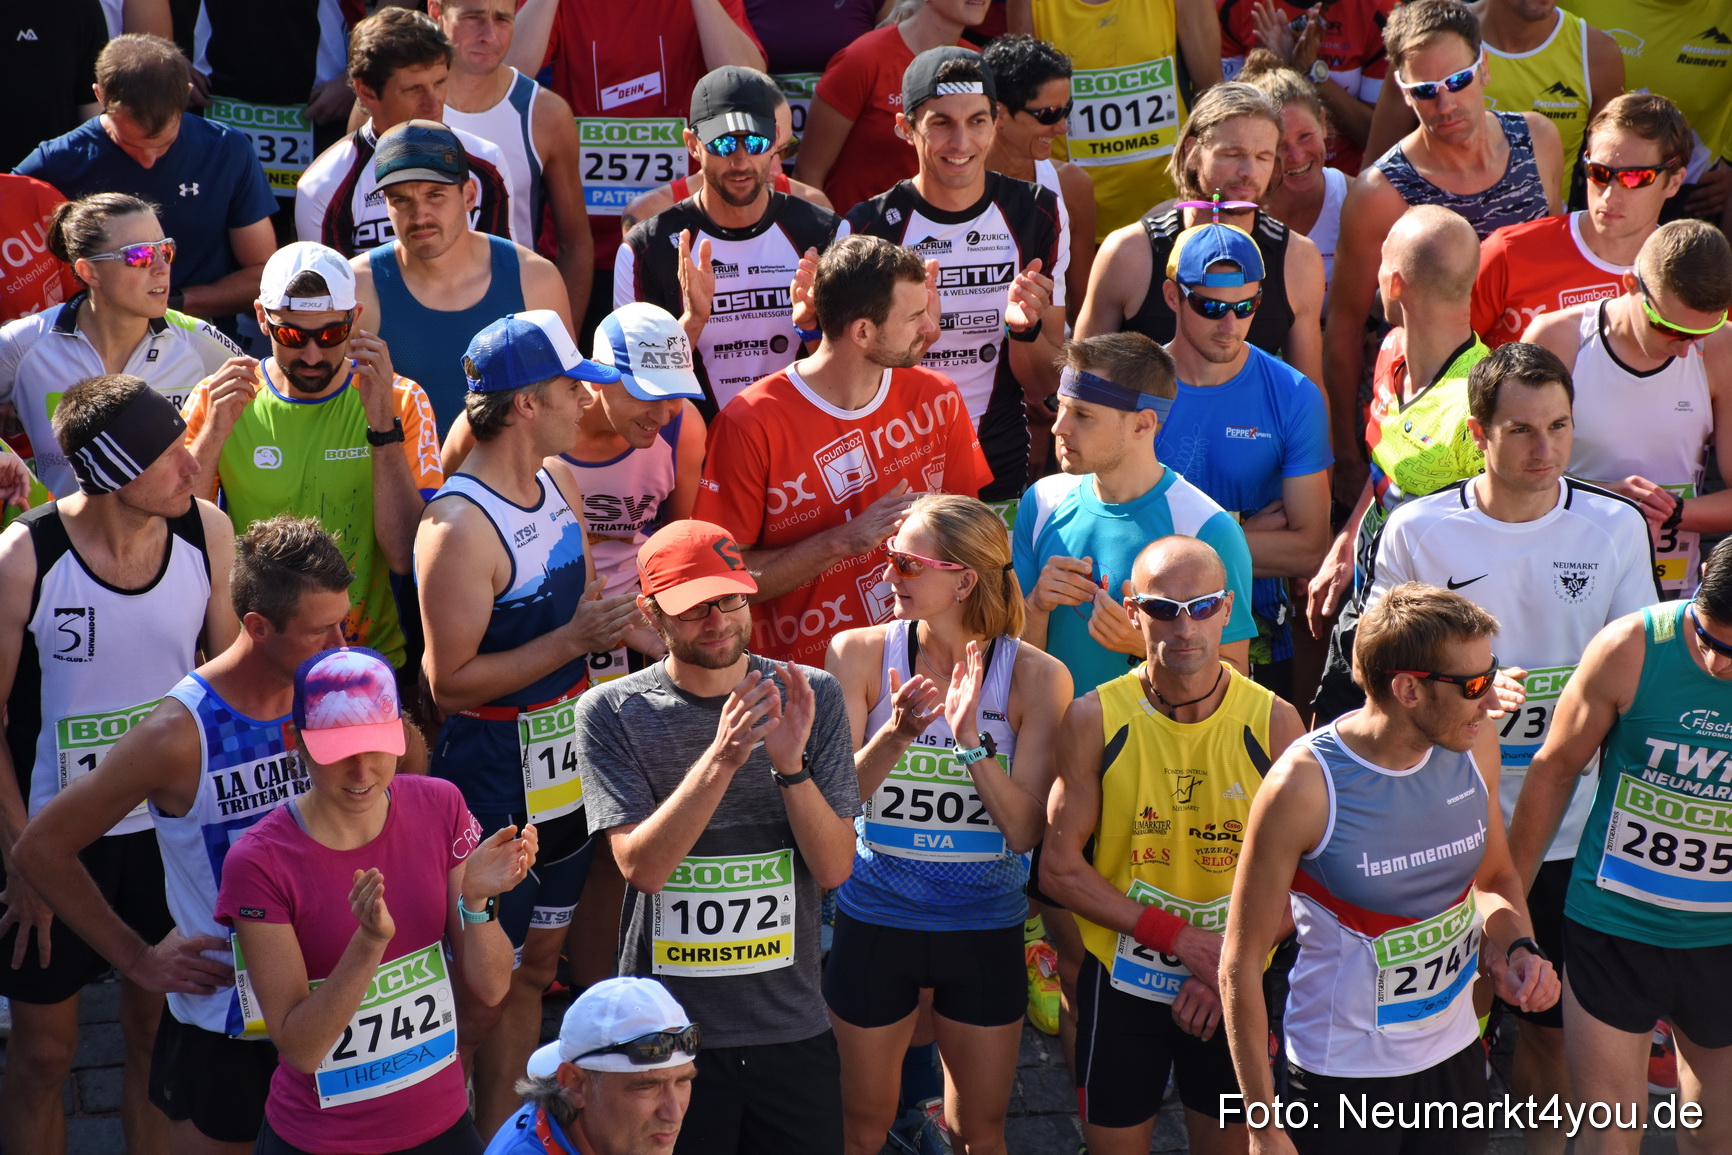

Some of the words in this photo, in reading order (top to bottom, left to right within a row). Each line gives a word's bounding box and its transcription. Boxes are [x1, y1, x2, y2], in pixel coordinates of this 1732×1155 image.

[1677, 53, 1728, 68] Runners
[618, 82, 645, 100] DEHN
[1073, 63, 1163, 94] BOCK
[213, 101, 303, 128] BOCK
[1079, 94, 1165, 133] 1012
[582, 124, 676, 143] BOCK
[1089, 133, 1160, 154] THOMAS
[244, 133, 299, 164] 32
[584, 152, 674, 182] 2573
[981, 233, 1009, 241] ZURICH
[6, 257, 55, 294] schenken
[713, 264, 739, 274] FRUM
[1563, 288, 1616, 305] raumbox
[641, 351, 691, 365] ATSV
[713, 339, 769, 353] BRÖTJE
[714, 349, 769, 360] HEIZUNG
[920, 358, 978, 367] HEIZUNG
[870, 390, 960, 459] raum
[326, 447, 369, 460] BOCK
[819, 435, 863, 466] raumbox
[581, 494, 656, 522] SV
[769, 505, 822, 533] outdoor
[513, 522, 538, 545] ATSV
[1553, 561, 1599, 570] NEUMARKT
[88, 606, 96, 657] SCHWANDORF
[53, 654, 83, 662] SKI-CLUB
[531, 708, 576, 736] BO
[1499, 706, 1557, 738] 73
[537, 741, 578, 780] 14
[212, 770, 248, 801] LA
[1642, 769, 1732, 806] NEUMAR
[217, 784, 290, 816] TRITEAM
[881, 786, 990, 826] 2502
[913, 833, 955, 849] EVA
[1142, 847, 1157, 860] &
[1161, 847, 1171, 861] S
[1195, 847, 1239, 859] PIZZERIA
[1356, 852, 1409, 877] team
[1410, 819, 1487, 867] memmert
[1622, 821, 1732, 875] 2835
[667, 859, 779, 886] BOCK
[1201, 855, 1233, 867] ELIO
[671, 894, 779, 936] 1072
[667, 940, 781, 963] CHRISTIAN
[1393, 928, 1474, 997] 2741
[1138, 971, 1181, 992] JÜR
[332, 993, 441, 1062] 2742
[336, 1045, 436, 1088] THERESA
